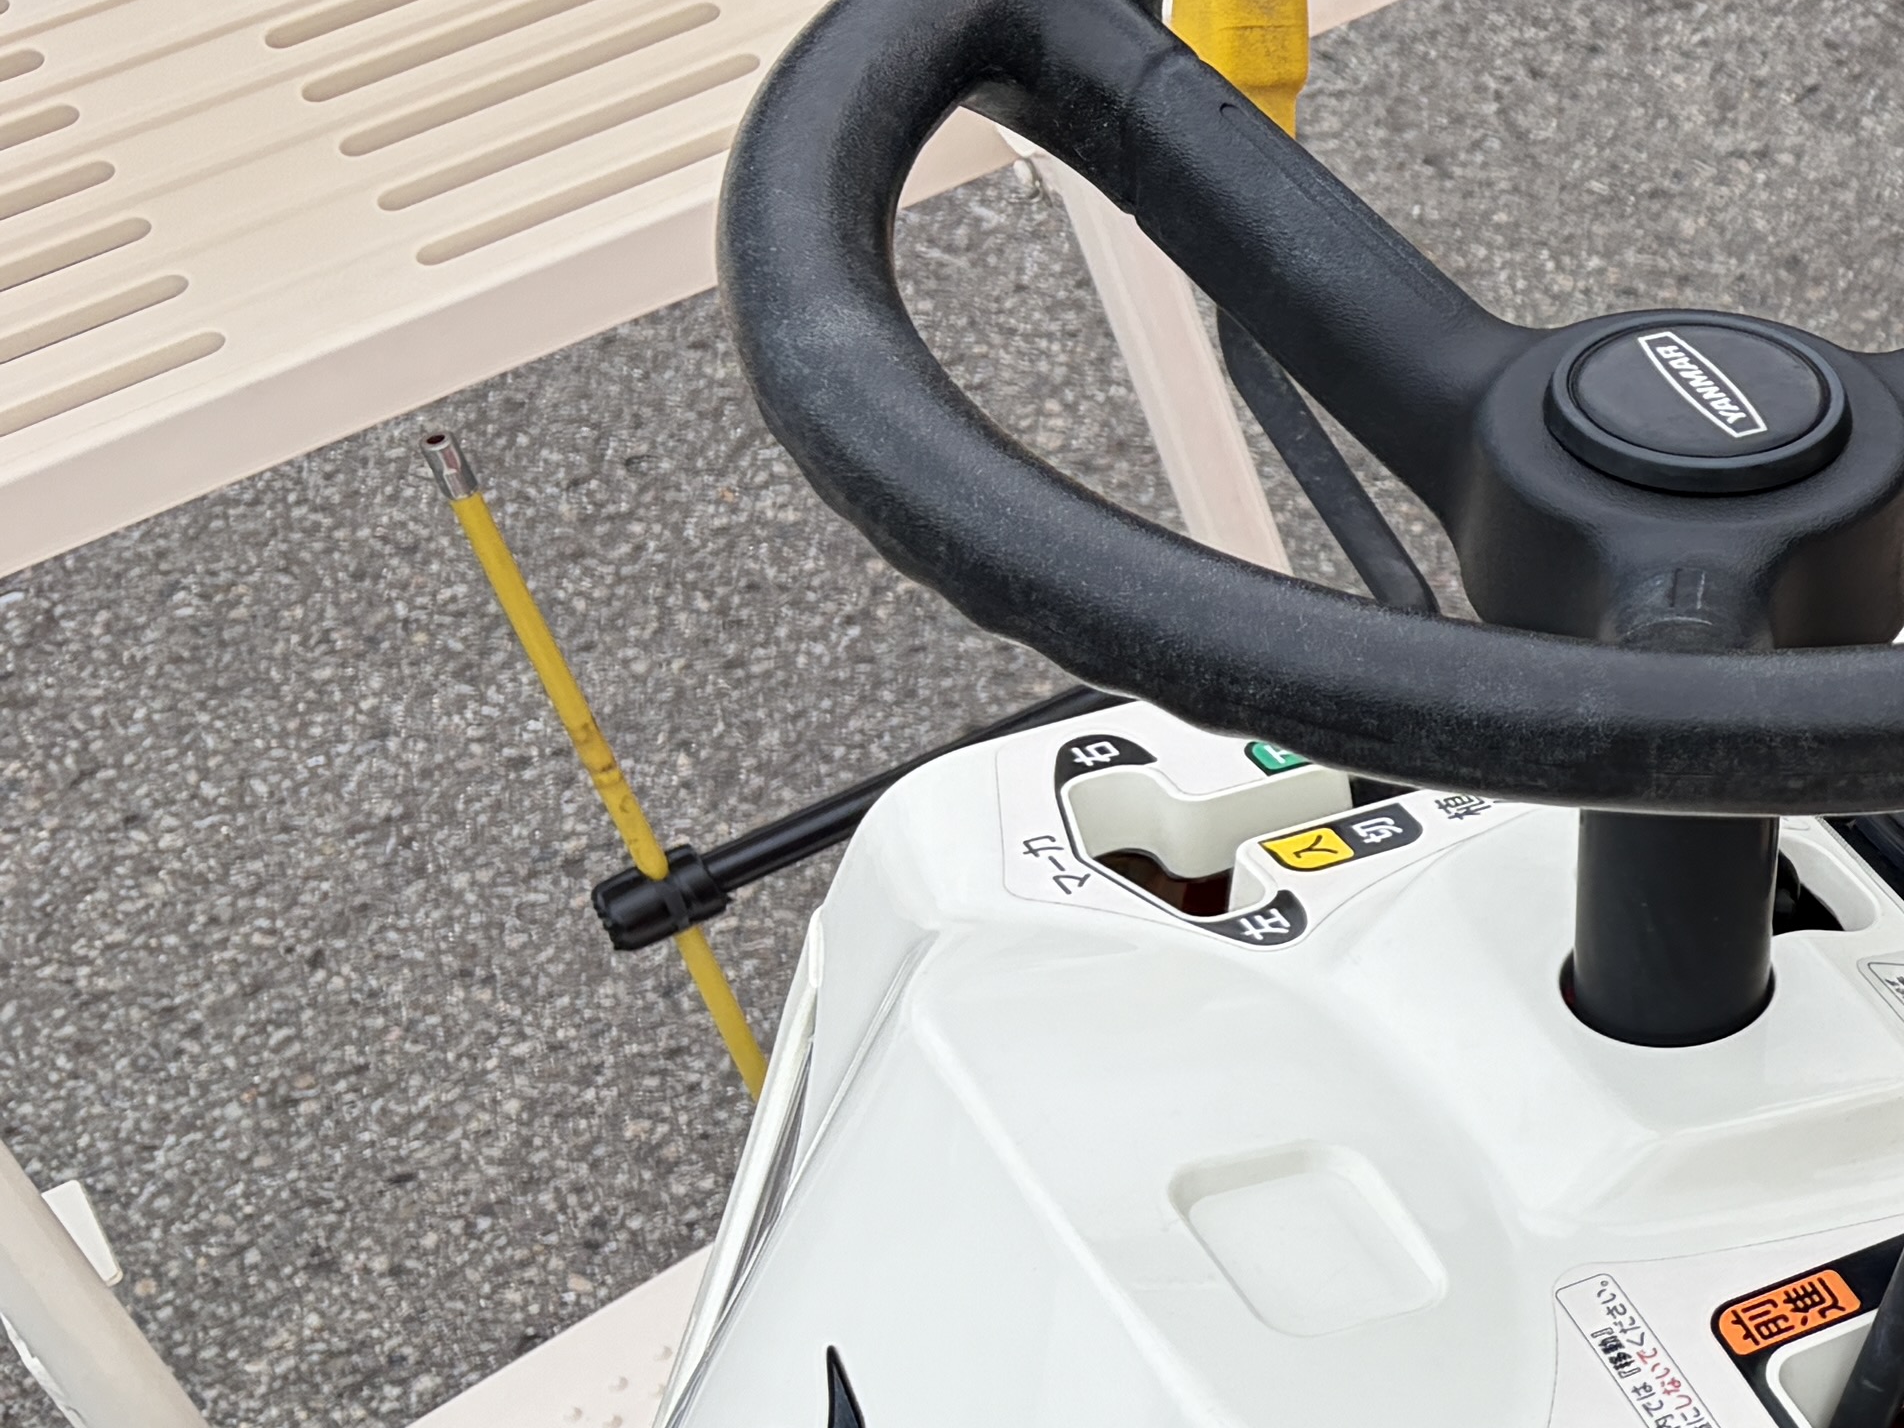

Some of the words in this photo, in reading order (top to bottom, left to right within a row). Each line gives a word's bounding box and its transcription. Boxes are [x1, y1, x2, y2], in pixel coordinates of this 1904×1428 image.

[1656, 345, 1747, 424] YANMAR
[1072, 739, 1121, 769] 右
[1434, 793, 1508, 822] 植
[1352, 814, 1404, 846] 切
[1021, 833, 1090, 896] マーカ
[1292, 834, 1340, 862] 入
[1239, 906, 1291, 941] 左
[1731, 1275, 1861, 1349] 前進
